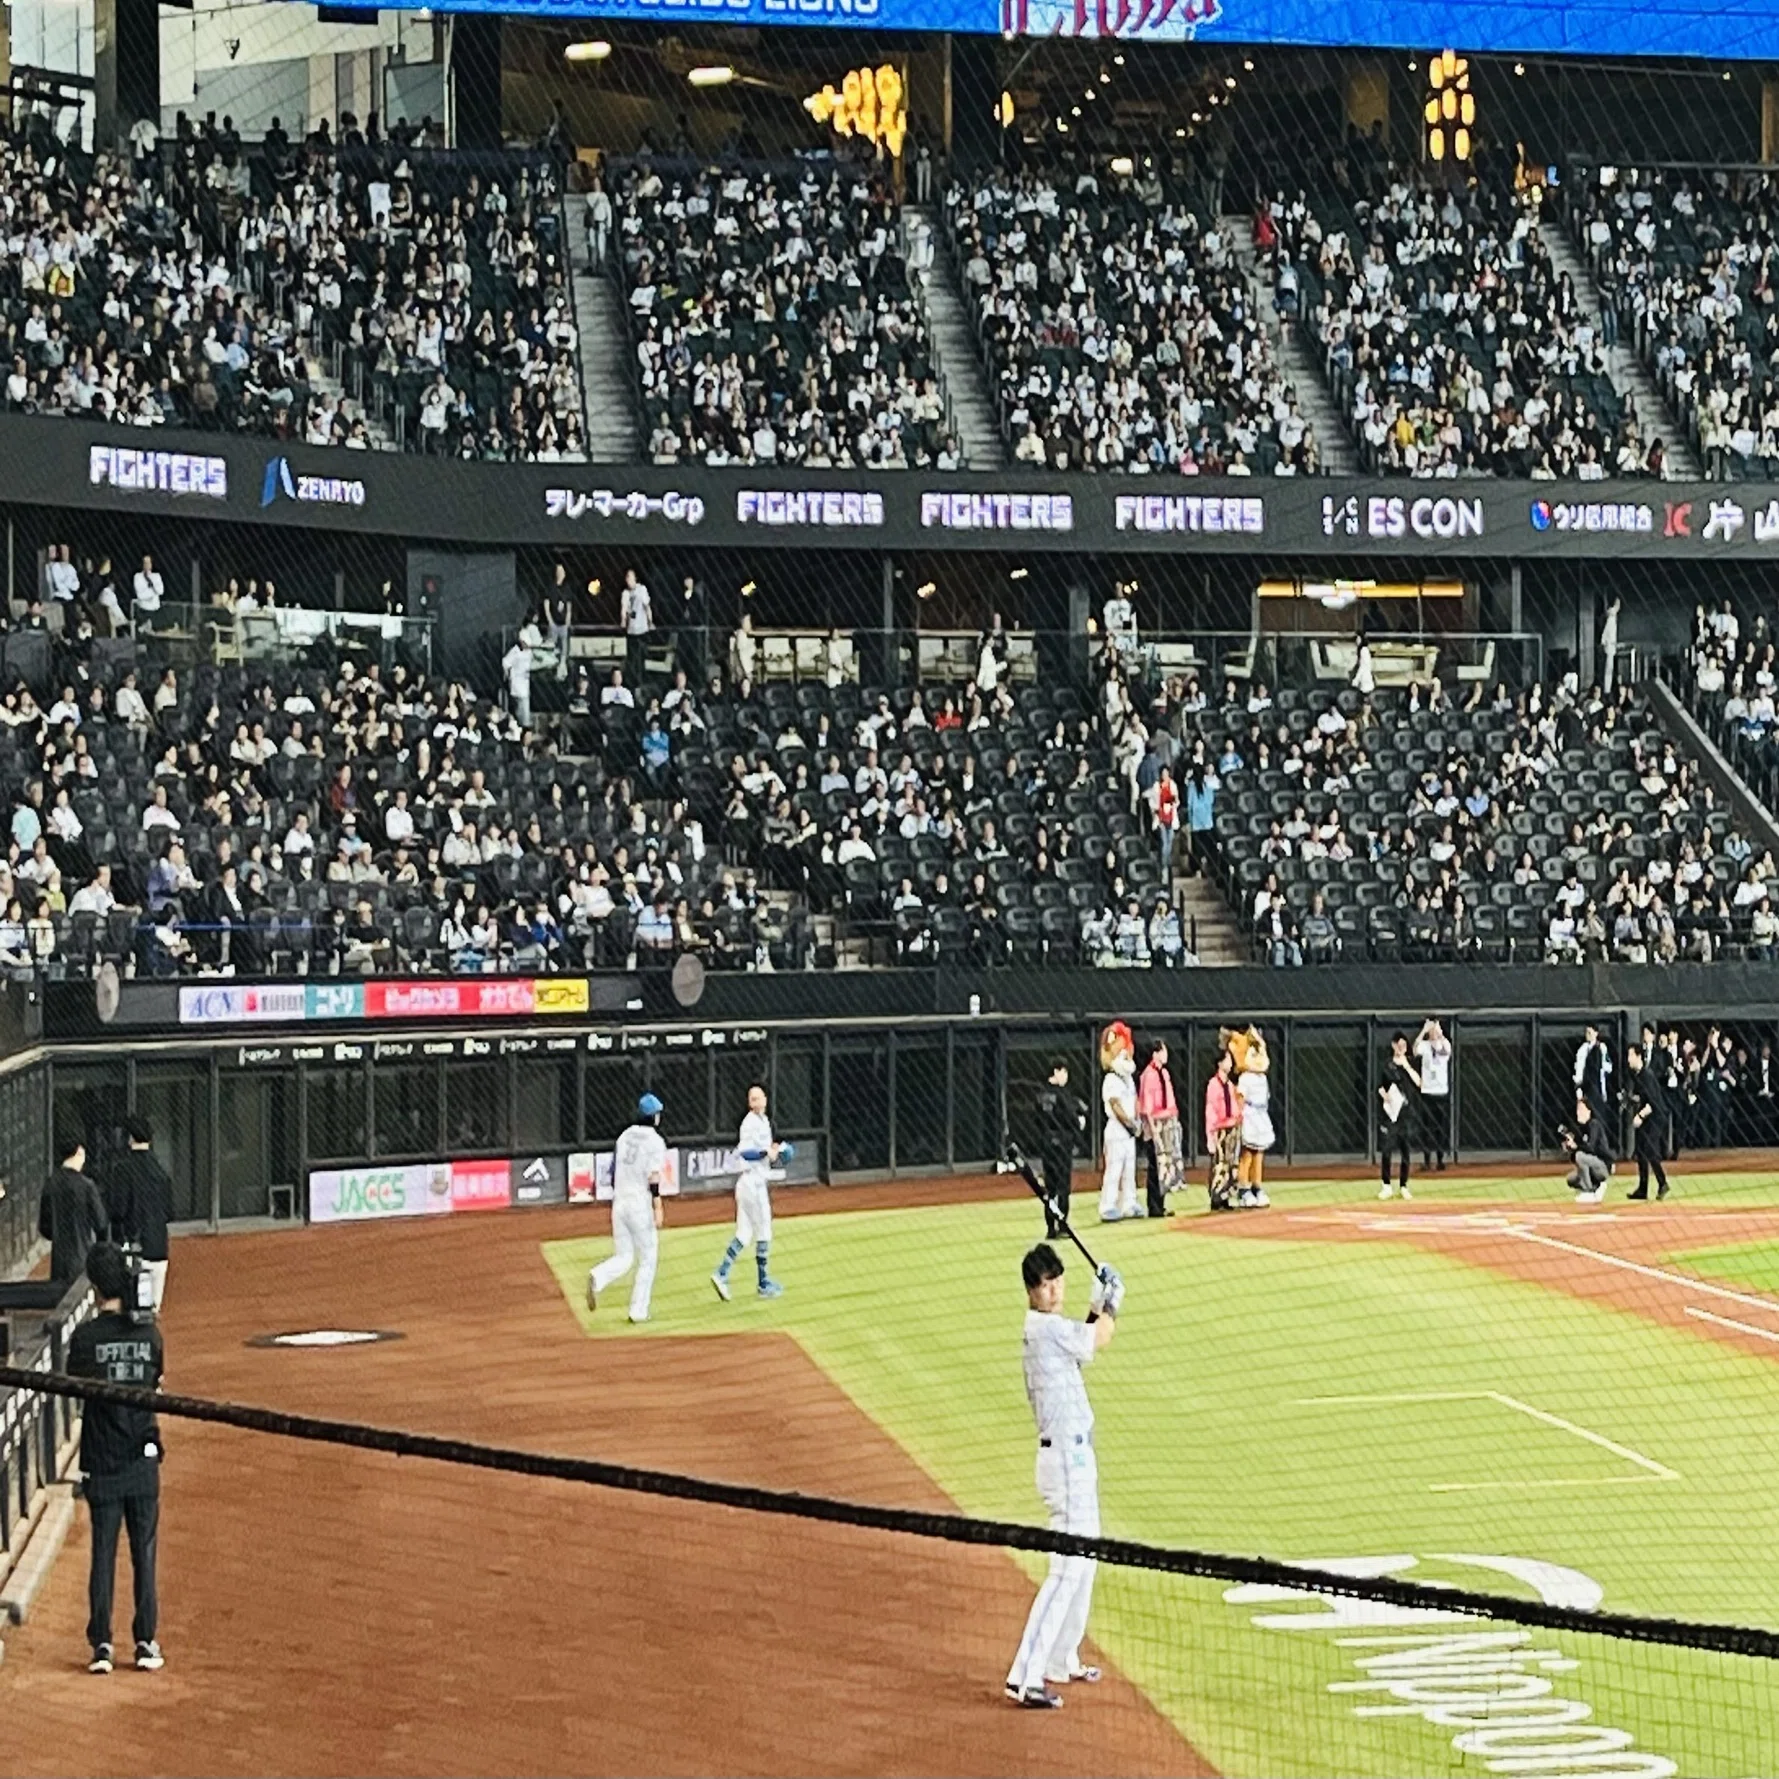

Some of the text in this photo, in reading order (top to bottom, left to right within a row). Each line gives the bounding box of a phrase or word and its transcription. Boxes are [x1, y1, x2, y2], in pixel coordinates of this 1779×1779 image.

[89, 445, 228, 498] FIGHTERS
[737, 490, 884, 526] FIGHTERS
[921, 493, 1074, 531] FIGHTERS
[1115, 496, 1265, 534] FIGHTERS
[331, 1172, 406, 1213] JACCS
[95, 1341, 151, 1364] OFFICIAL
